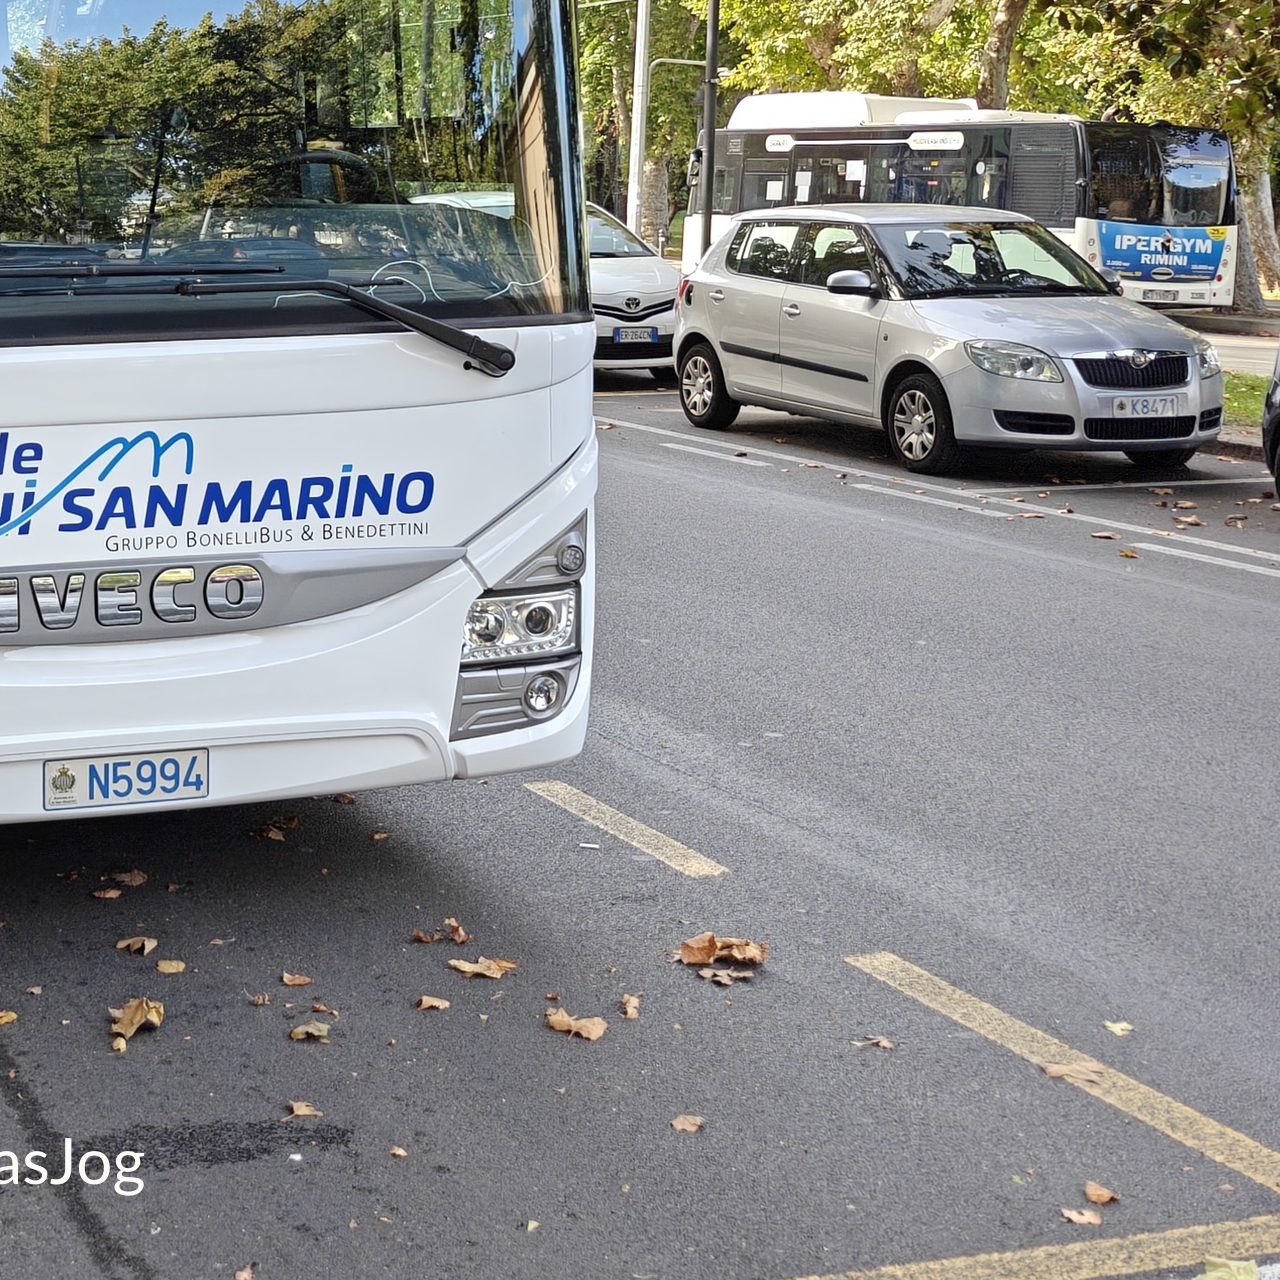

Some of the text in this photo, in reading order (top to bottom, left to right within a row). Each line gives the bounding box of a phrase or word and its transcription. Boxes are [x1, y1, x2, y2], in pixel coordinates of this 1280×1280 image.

[1114, 234, 1213, 254] IPER GYM
[1140, 253, 1188, 266] RIMINI
[1131, 399, 1175, 415] K8471
[57, 483, 189, 532] SAN
[197, 464, 434, 526] MARINO
[301, 525, 314, 541] &
[88, 756, 204, 800] N5994
